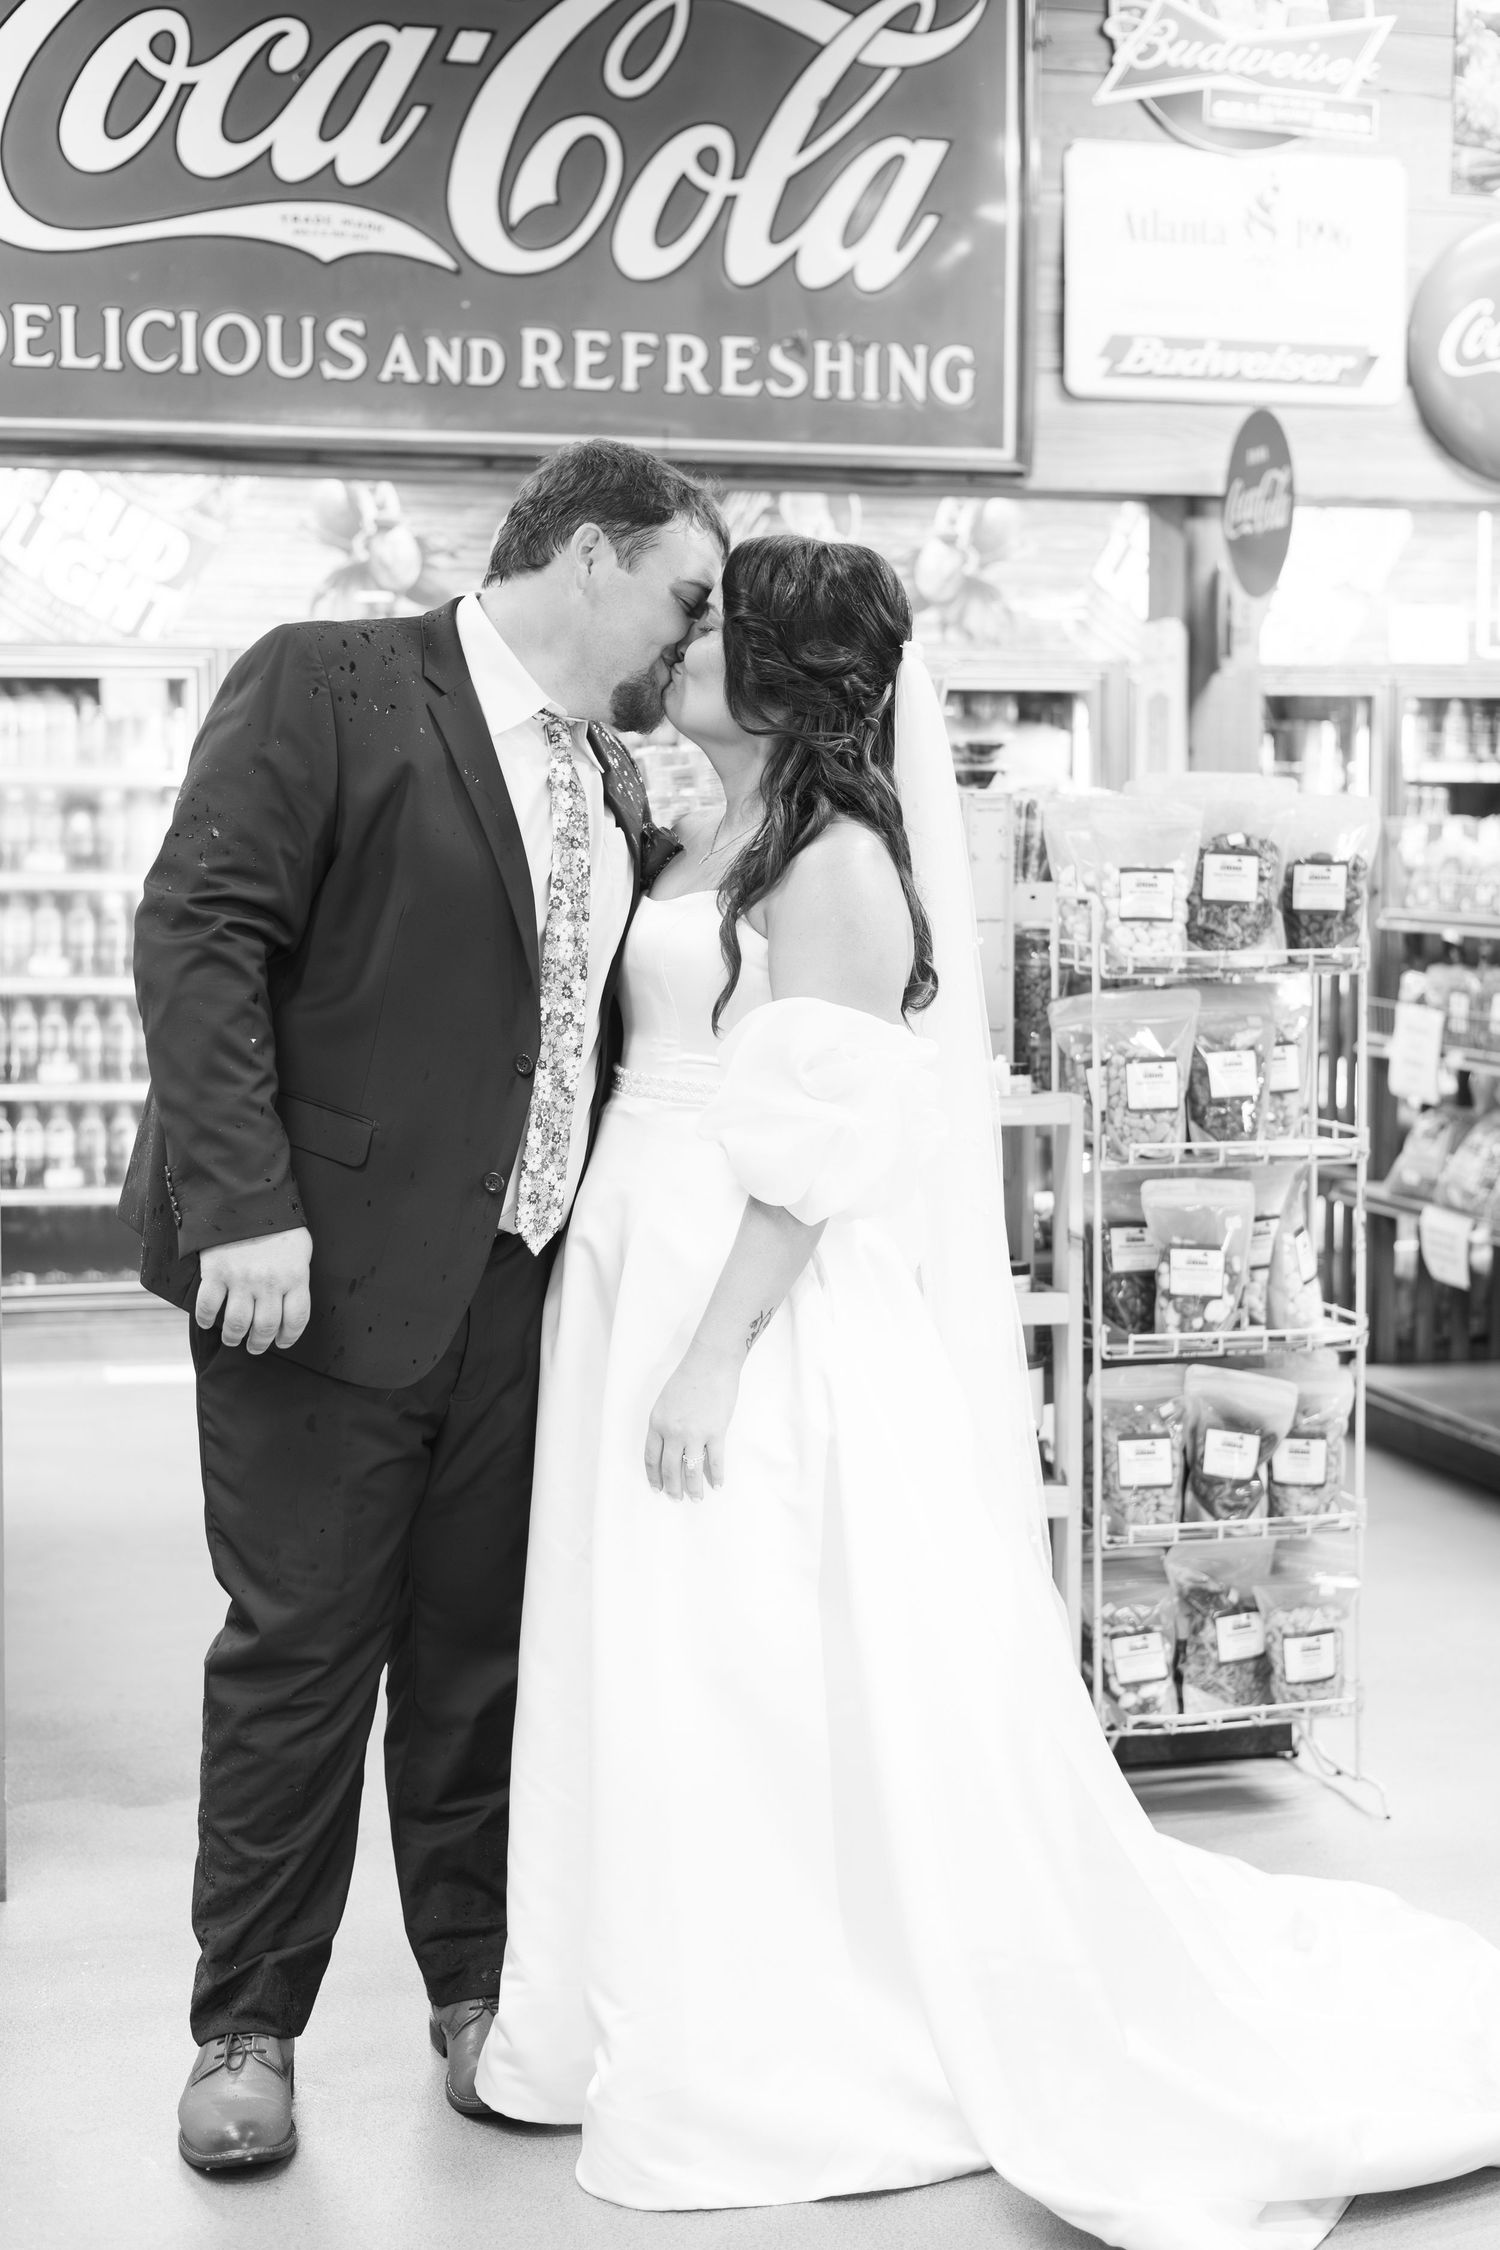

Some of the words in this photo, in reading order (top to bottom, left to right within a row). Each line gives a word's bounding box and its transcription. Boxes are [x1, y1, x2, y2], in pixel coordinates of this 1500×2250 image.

[1104, 10, 1382, 84] Budweiser
[1122, 207, 1228, 247] Atlanta
[0, 303, 369, 381] ELICIOUS
[377, 332, 506, 387] AND
[518, 326, 977, 406] REFRESHING
[1115, 335, 1358, 384] Budweiser
